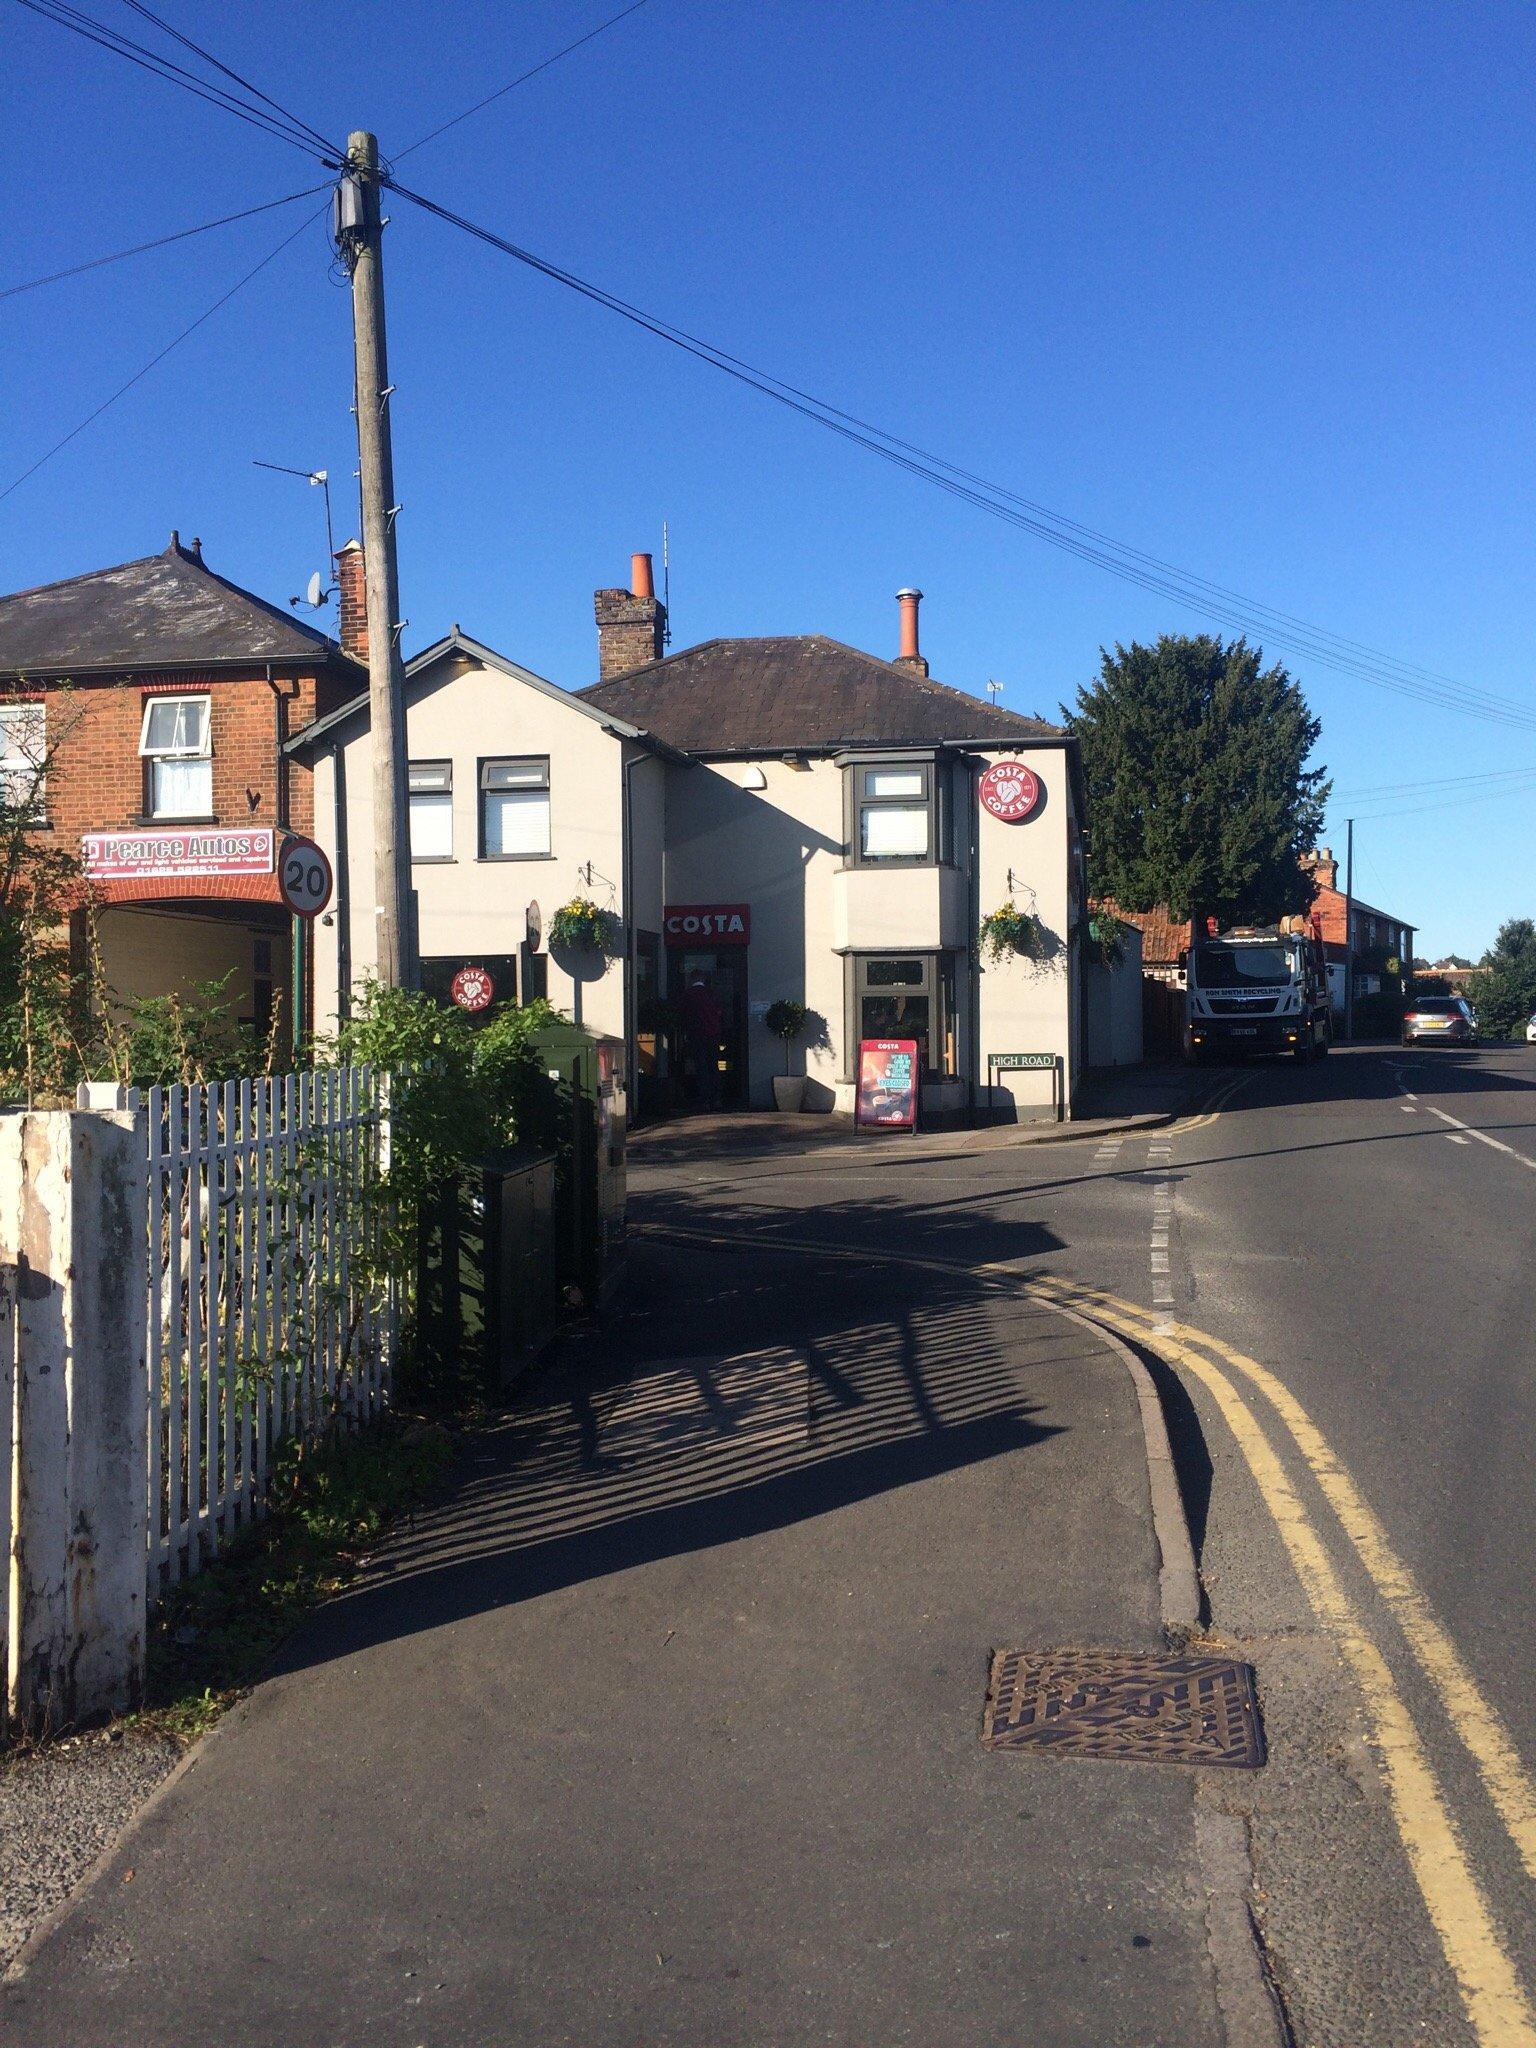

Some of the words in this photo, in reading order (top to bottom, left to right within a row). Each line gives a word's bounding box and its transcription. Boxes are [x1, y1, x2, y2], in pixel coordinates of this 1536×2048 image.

[989, 767, 1026, 783] COSTA
[987, 796, 1030, 813] COFFEE
[105, 839, 183, 860] Pearce
[188, 836, 250, 857] Autos
[154, 859, 169, 867] light
[171, 857, 197, 865] vehicles
[242, 855, 270, 863] repaired
[287, 861, 324, 897] 20
[667, 914, 745, 936] COSTA
[459, 972, 485, 984] COSTA
[1244, 987, 1281, 996] RECYCLING
[458, 993, 489, 1006] COFFEE
[993, 1056, 1018, 1066] HIGH
[1021, 1056, 1051, 1065] ROAD
